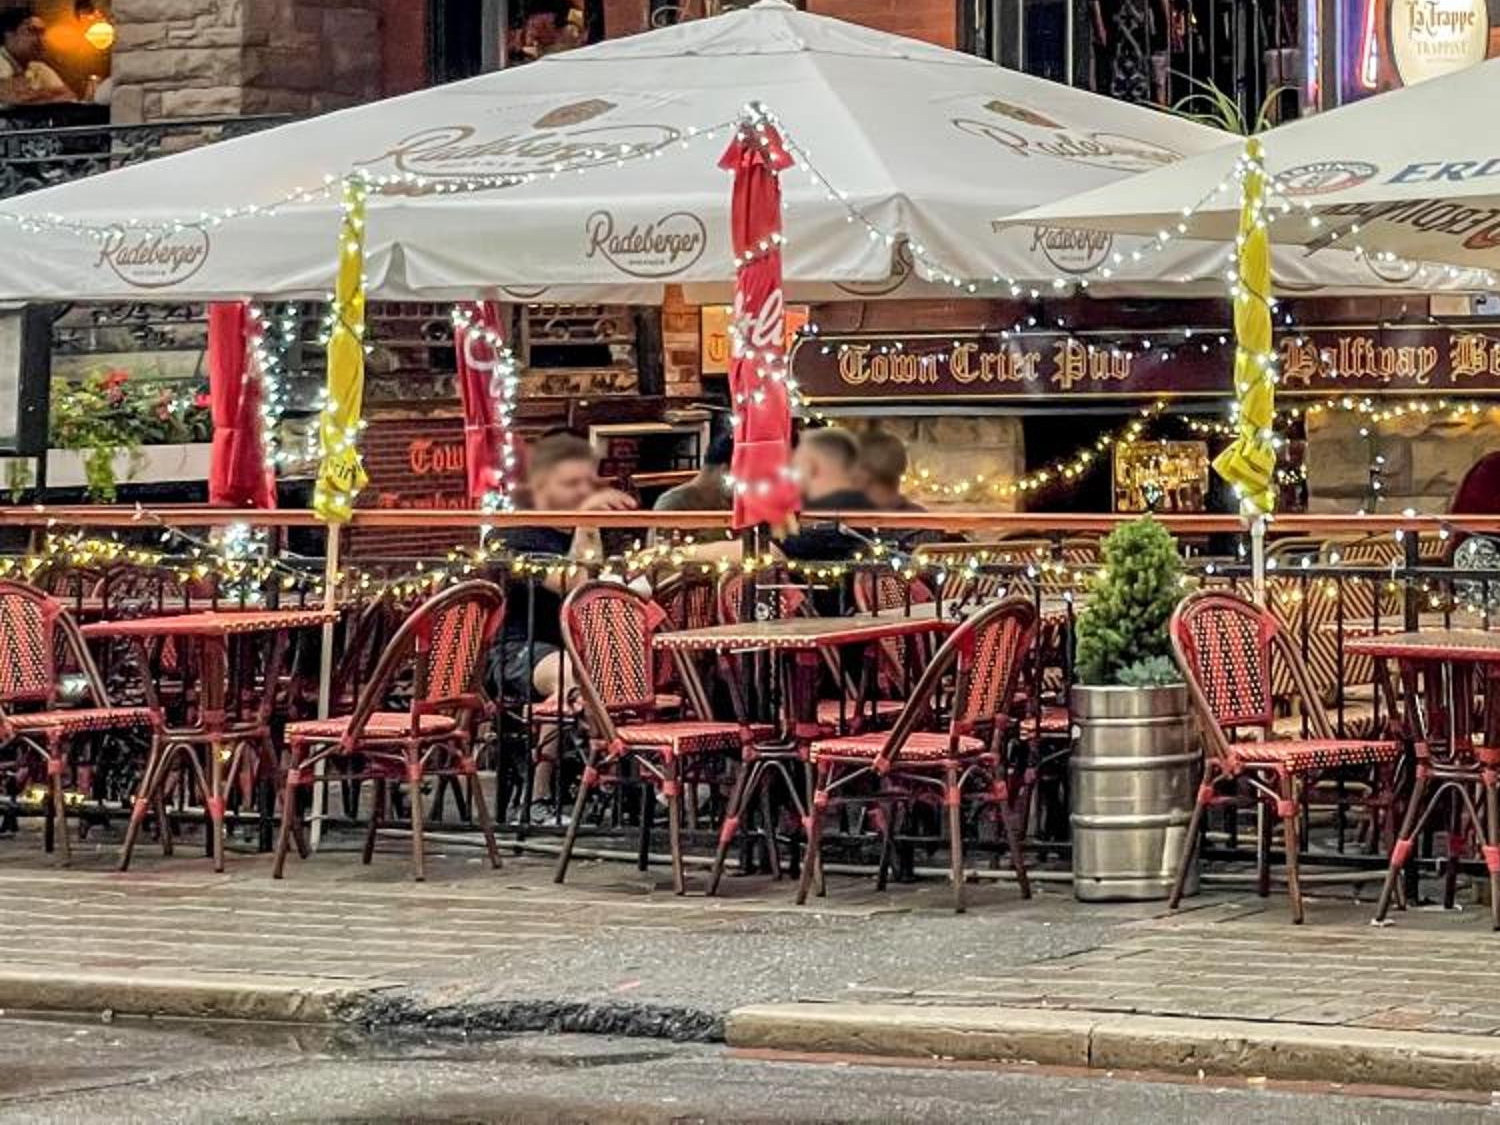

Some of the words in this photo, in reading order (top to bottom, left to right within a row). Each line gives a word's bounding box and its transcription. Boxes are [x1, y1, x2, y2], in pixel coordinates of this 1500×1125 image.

[1423, 0, 1476, 37] Trappe
[585, 210, 704, 272] Radeberger
[837, 342, 939, 385] Town
[950, 341, 1041, 384] Crier
[1050, 337, 1132, 389] Pub
[1279, 334, 1438, 384] Halfway
